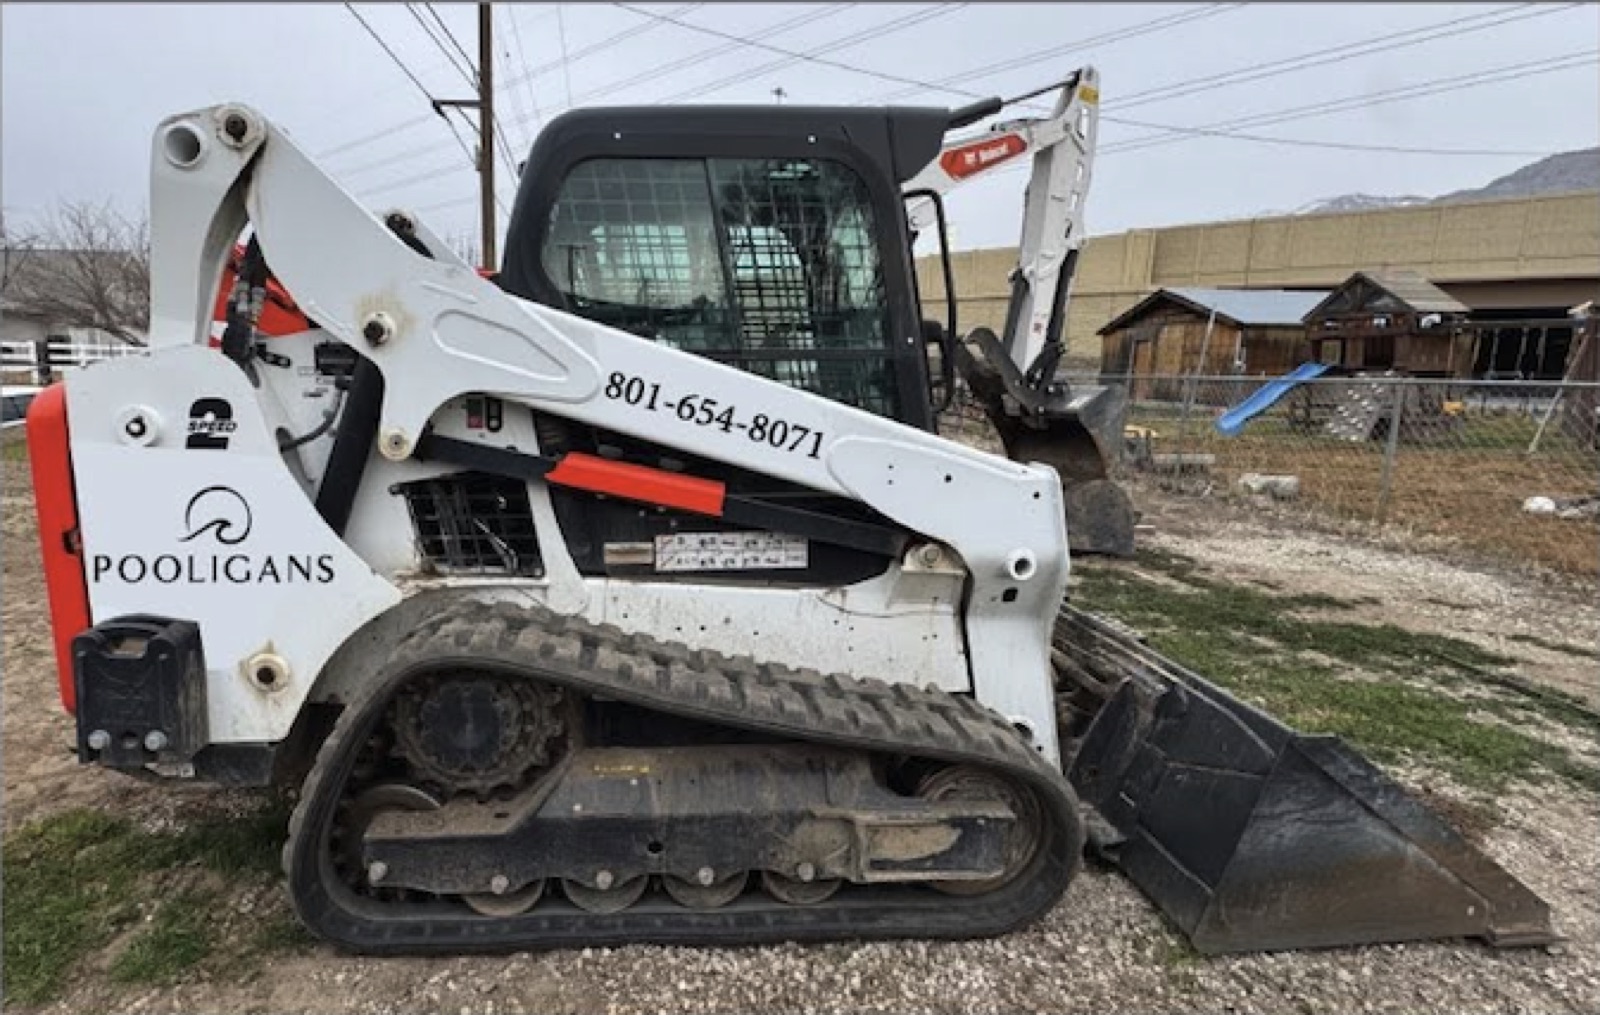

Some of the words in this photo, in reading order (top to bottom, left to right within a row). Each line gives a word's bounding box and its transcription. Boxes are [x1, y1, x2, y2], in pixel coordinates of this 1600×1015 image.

[185, 397, 233, 450] 2
[187, 420, 239, 433] SPEED
[605, 371, 823, 459] 801-654-8071
[93, 553, 335, 583] POOLIGANS
